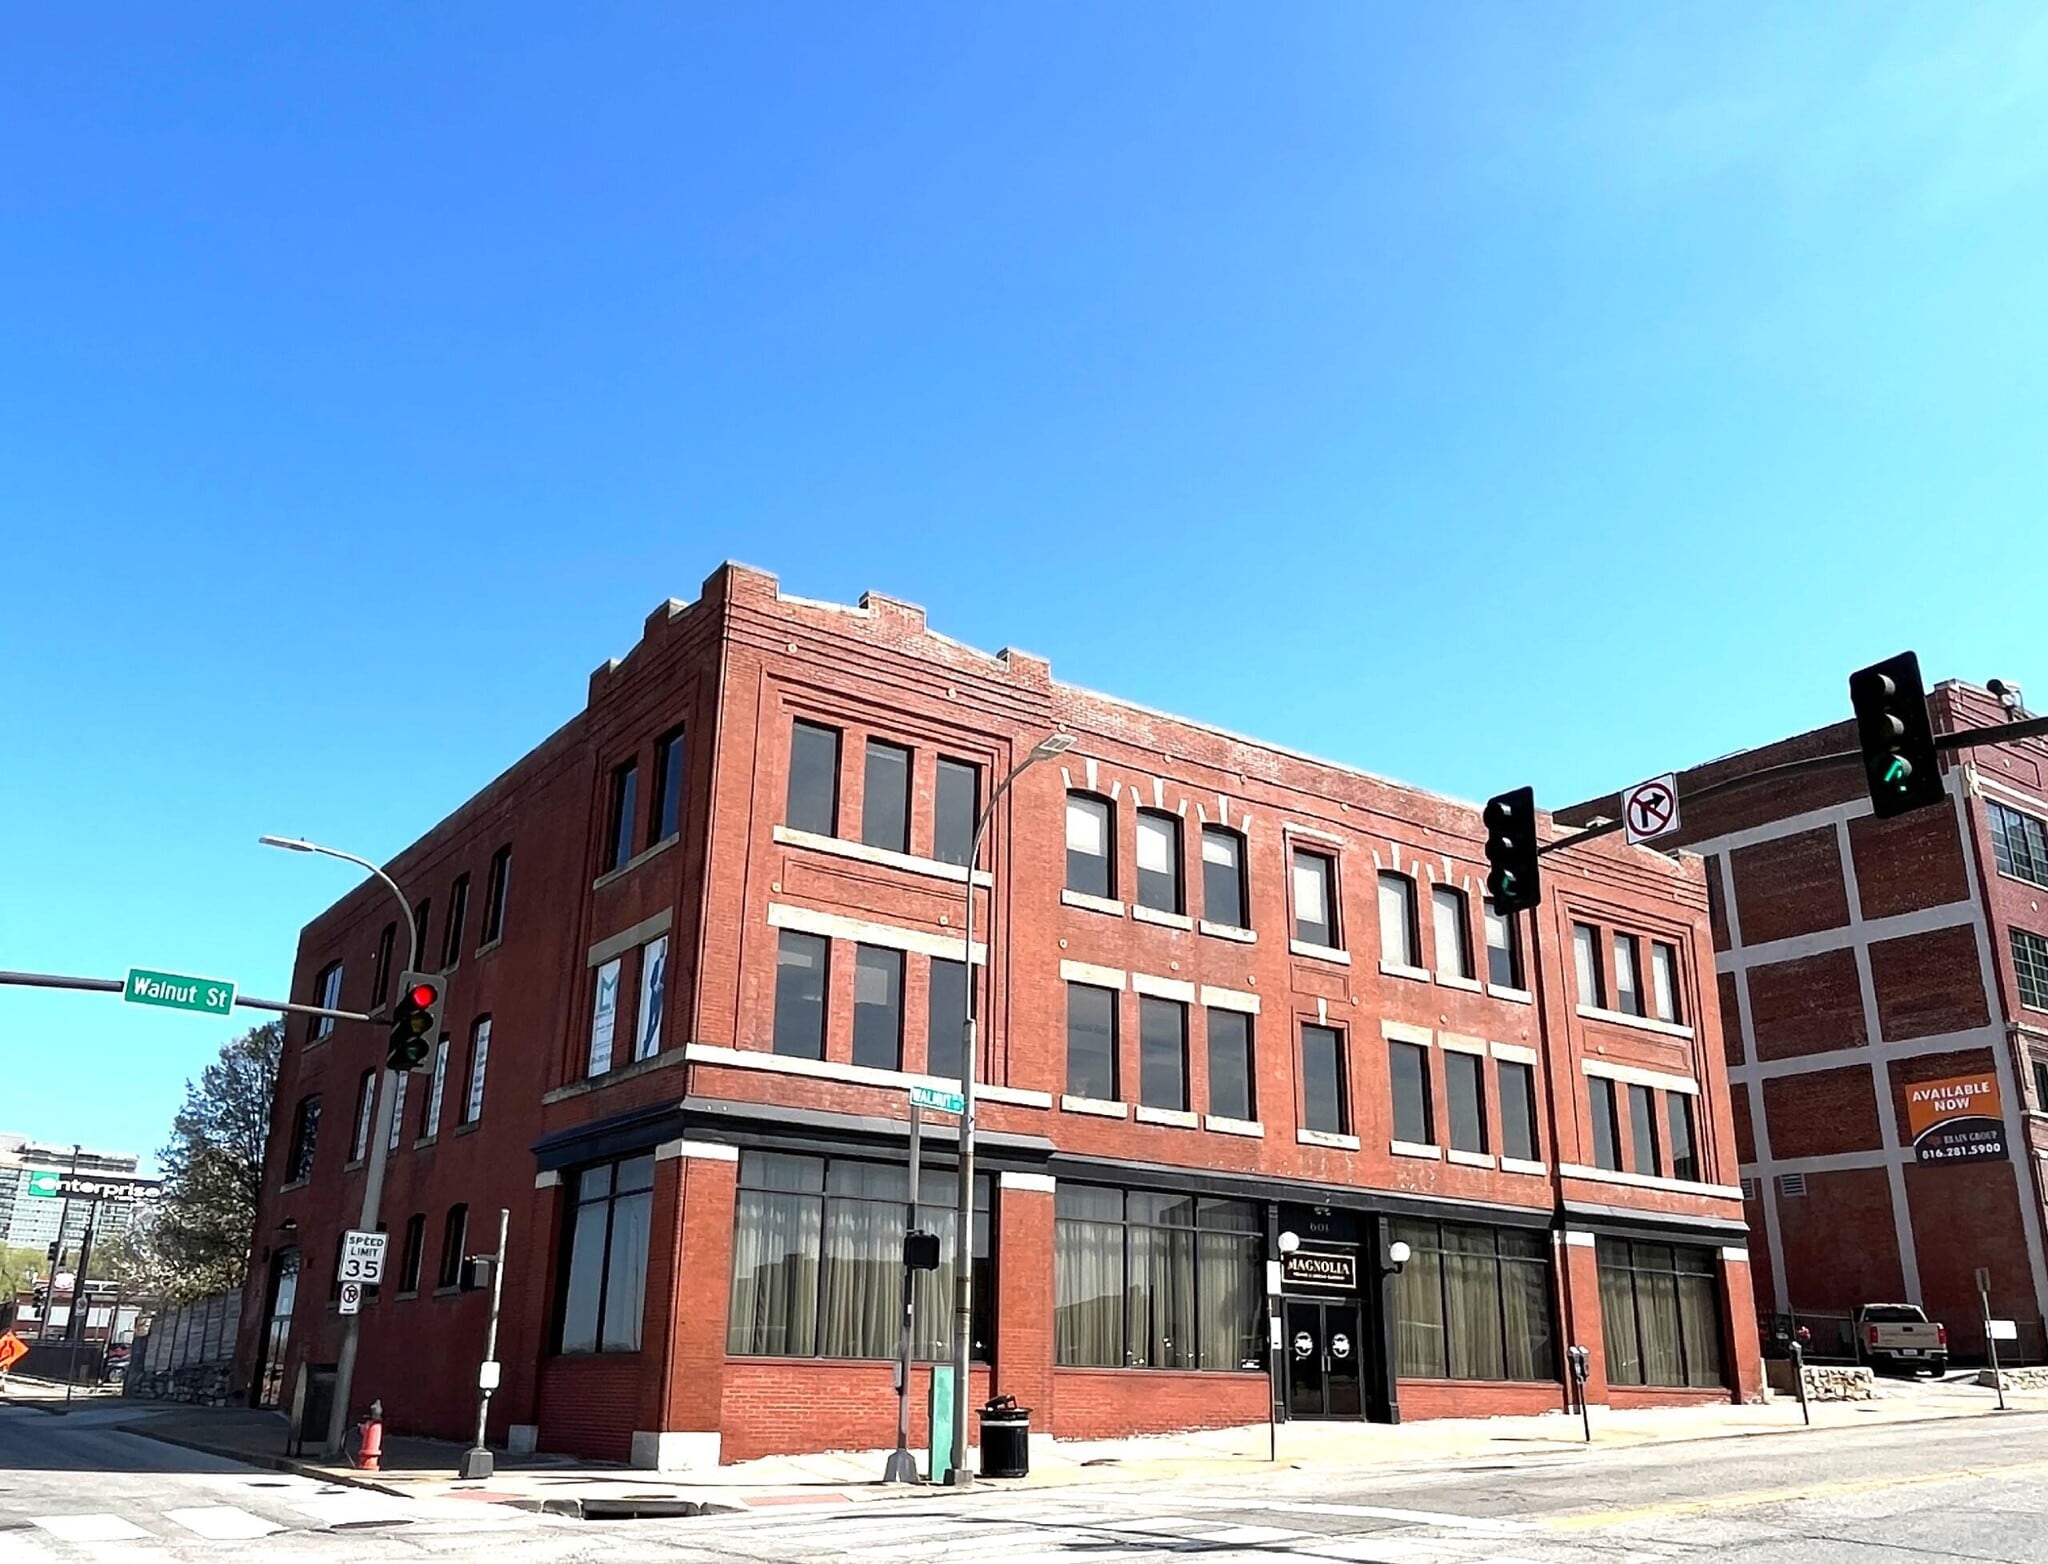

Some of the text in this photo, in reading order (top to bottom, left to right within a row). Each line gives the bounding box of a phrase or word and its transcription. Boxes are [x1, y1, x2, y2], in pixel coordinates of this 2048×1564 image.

[134, 976, 227, 1008] Walnut St
[912, 1088, 951, 1108] WALNUT
[1912, 1082, 1991, 1102] AVAILABLE
[1934, 1097, 1970, 1112] NOW
[1922, 1143, 2001, 1159] 816.281.5900
[30, 1177, 160, 1199] enterprise
[1309, 1222, 1330, 1233] 601
[348, 1236, 384, 1247] SPEED
[350, 1247, 379, 1257] LIMIT
[345, 1259, 378, 1278] 35
[1287, 1258, 1350, 1275] MAGNOLIA
